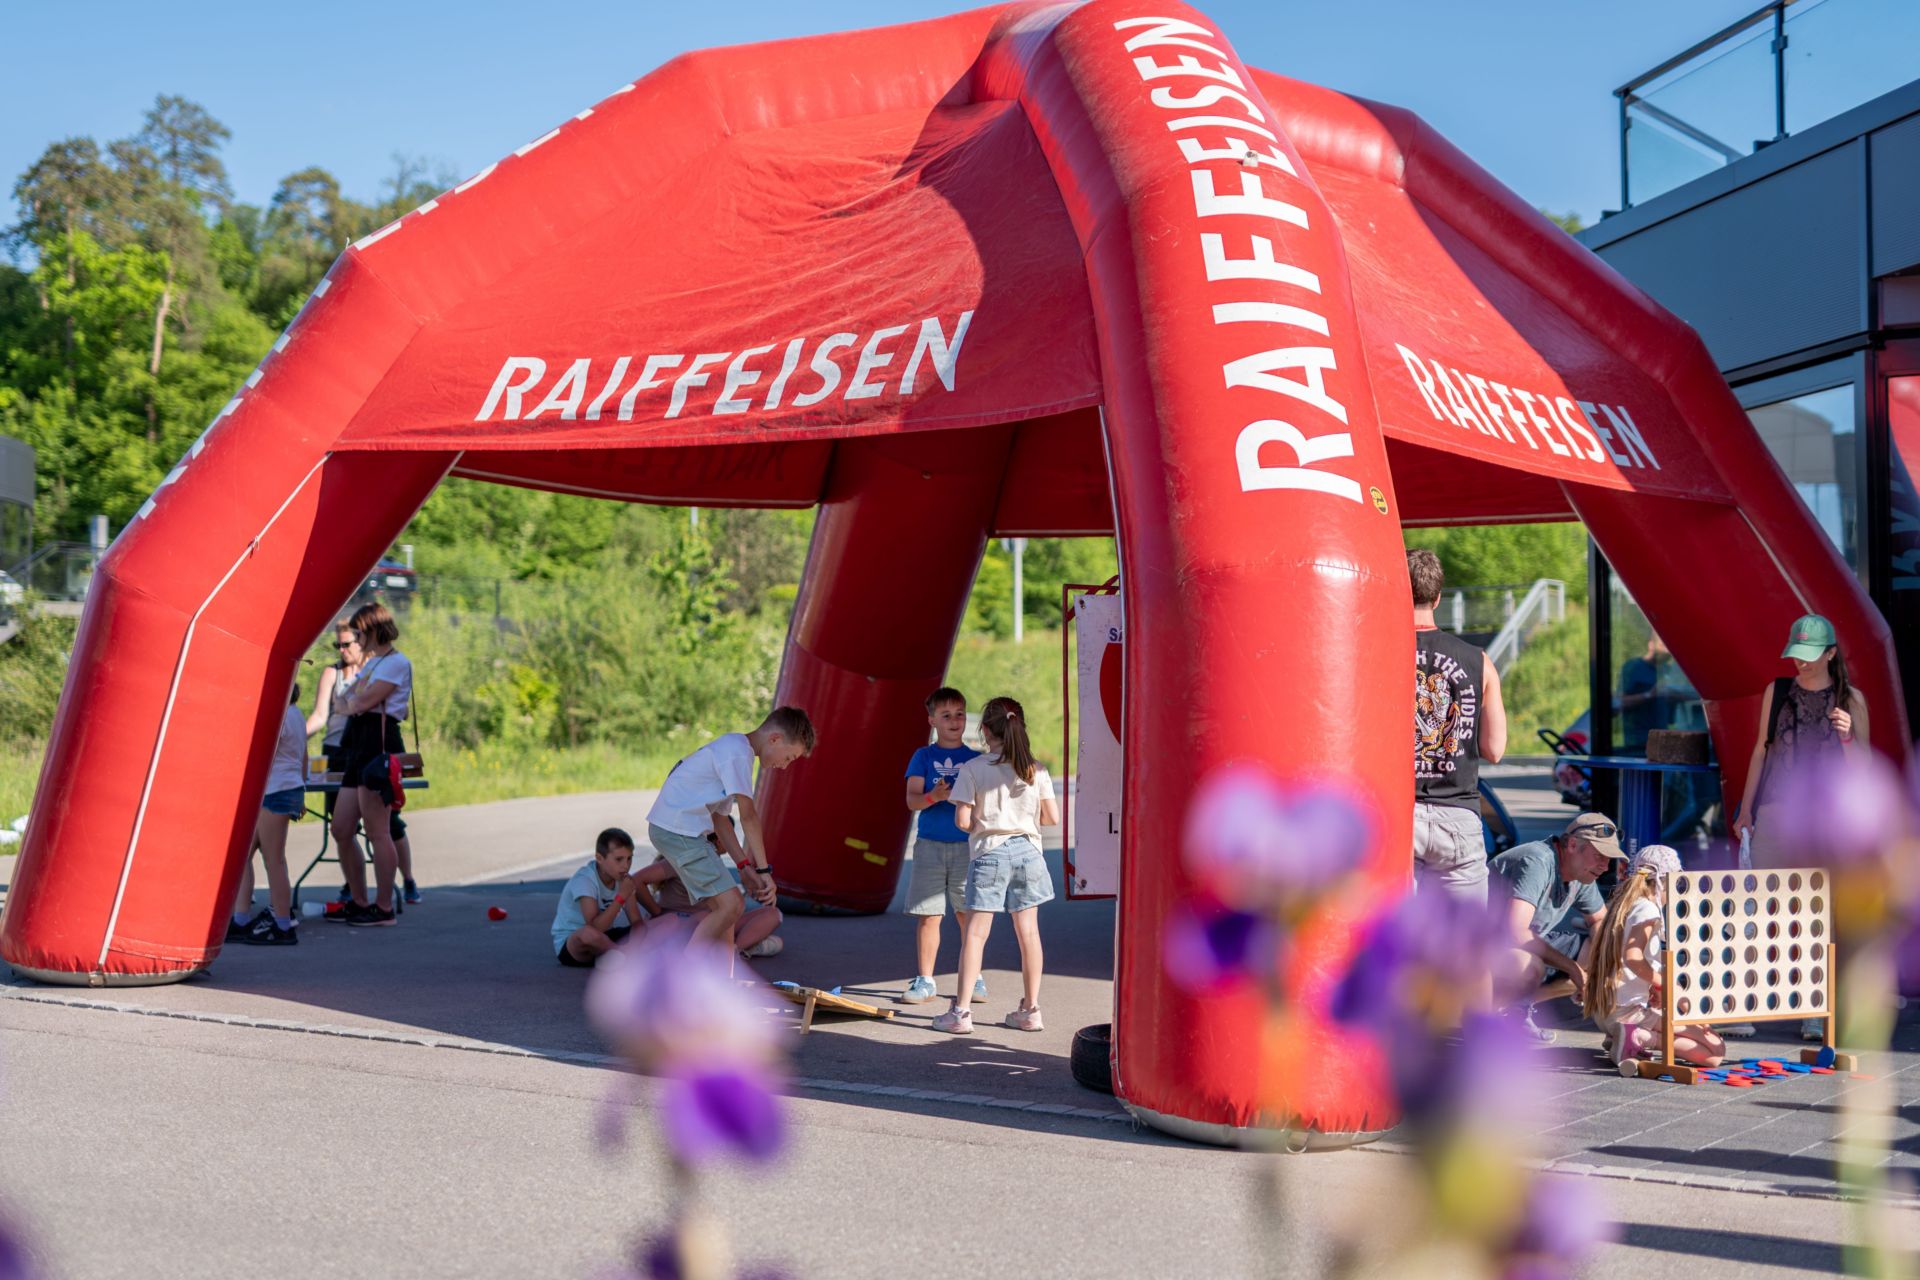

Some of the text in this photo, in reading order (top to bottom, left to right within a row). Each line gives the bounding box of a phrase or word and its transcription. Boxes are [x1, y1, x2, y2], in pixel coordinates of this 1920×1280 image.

[1114, 17, 1363, 504] RAIFFEISEN
[474, 310, 974, 421] RAIFFEISEN
[1394, 342, 1661, 470] RAIFFEISEN
[1433, 652, 1476, 740] THE TIDES
